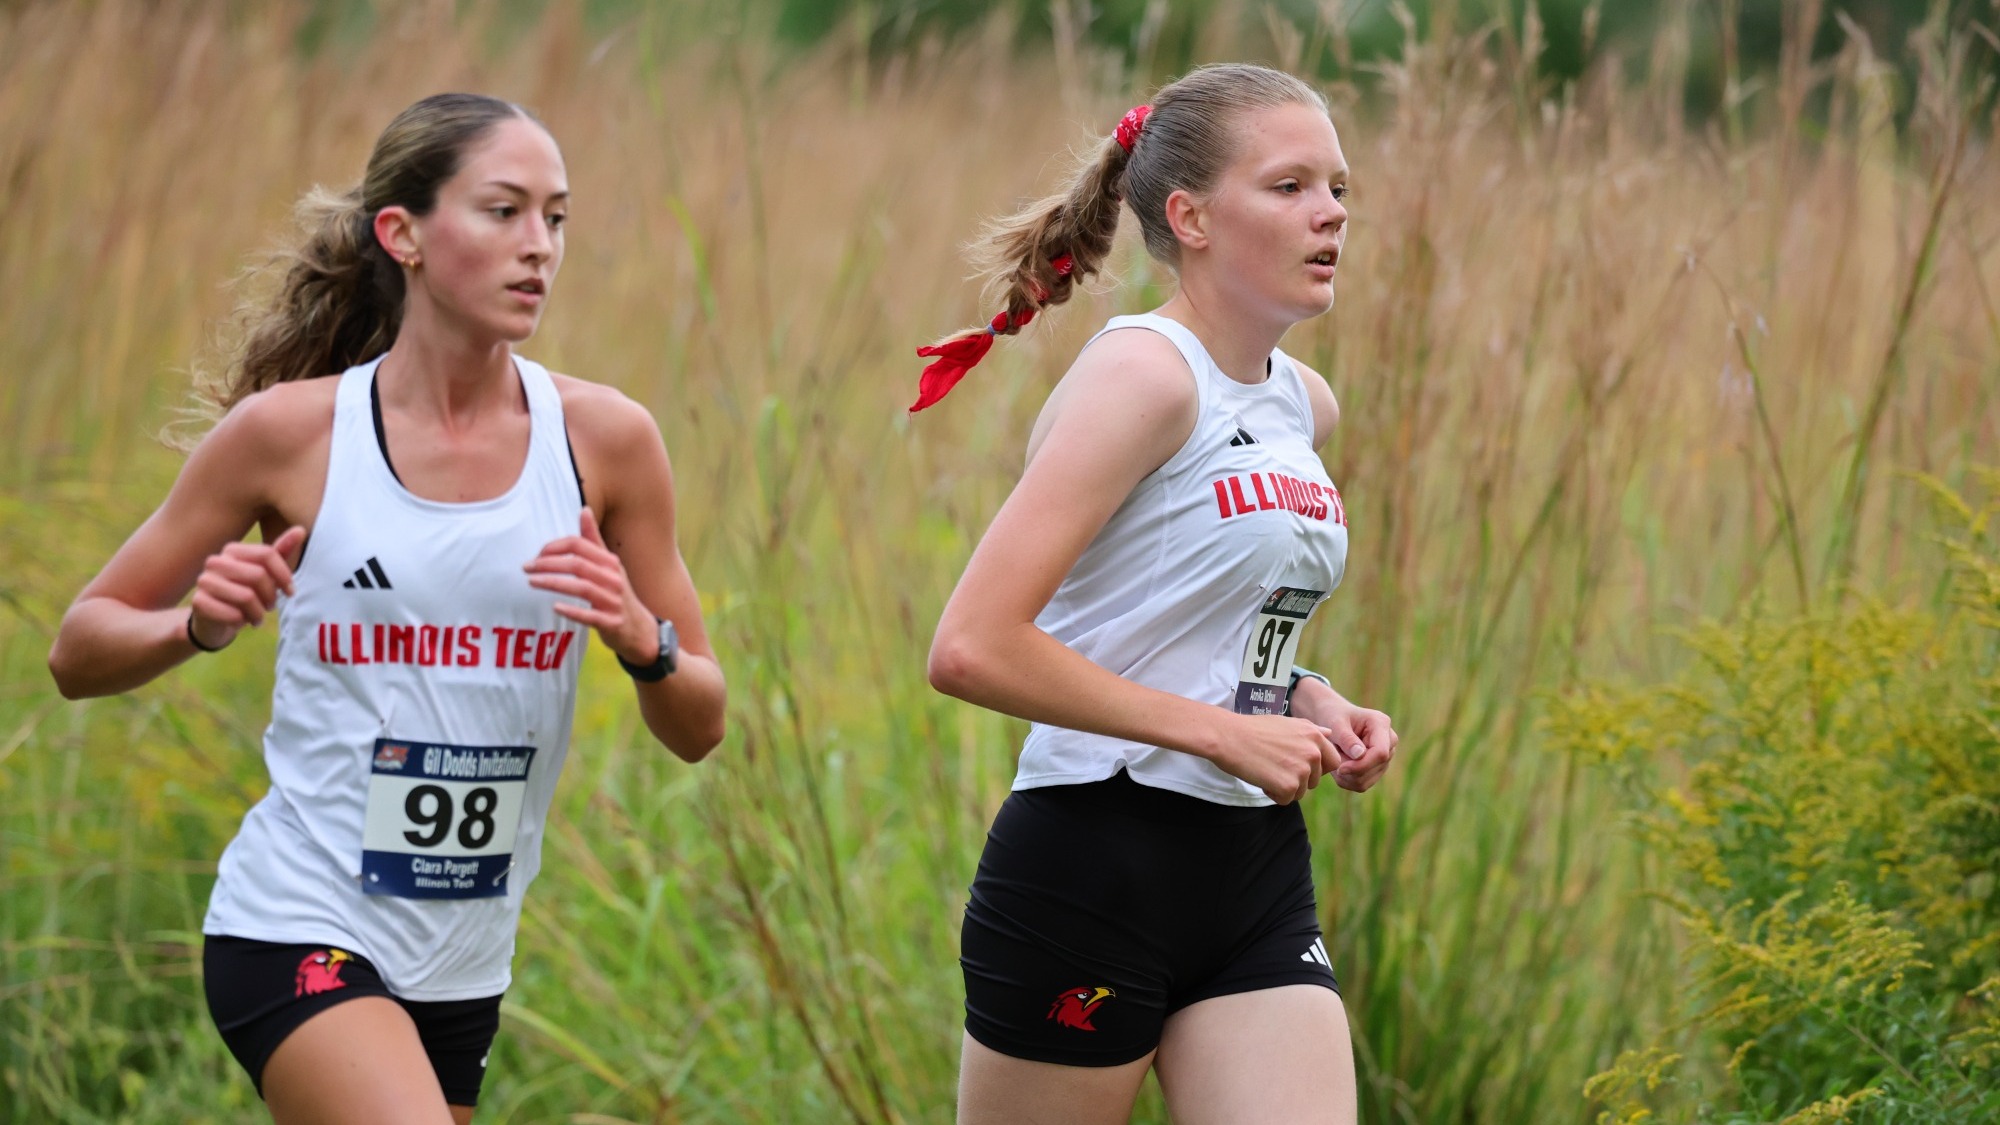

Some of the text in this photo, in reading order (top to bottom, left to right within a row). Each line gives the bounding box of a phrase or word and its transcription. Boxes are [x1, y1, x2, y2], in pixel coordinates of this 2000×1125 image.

[1213, 472, 1327, 520] ILLINOIS
[318, 623, 482, 667] ILLINOIS
[1253, 618, 1295, 679] 97
[423, 746, 531, 778] Gil Dodds Invitational
[403, 784, 498, 849] 98
[411, 857, 442, 874] Clara
[415, 876, 475, 889] Illinois Tech
